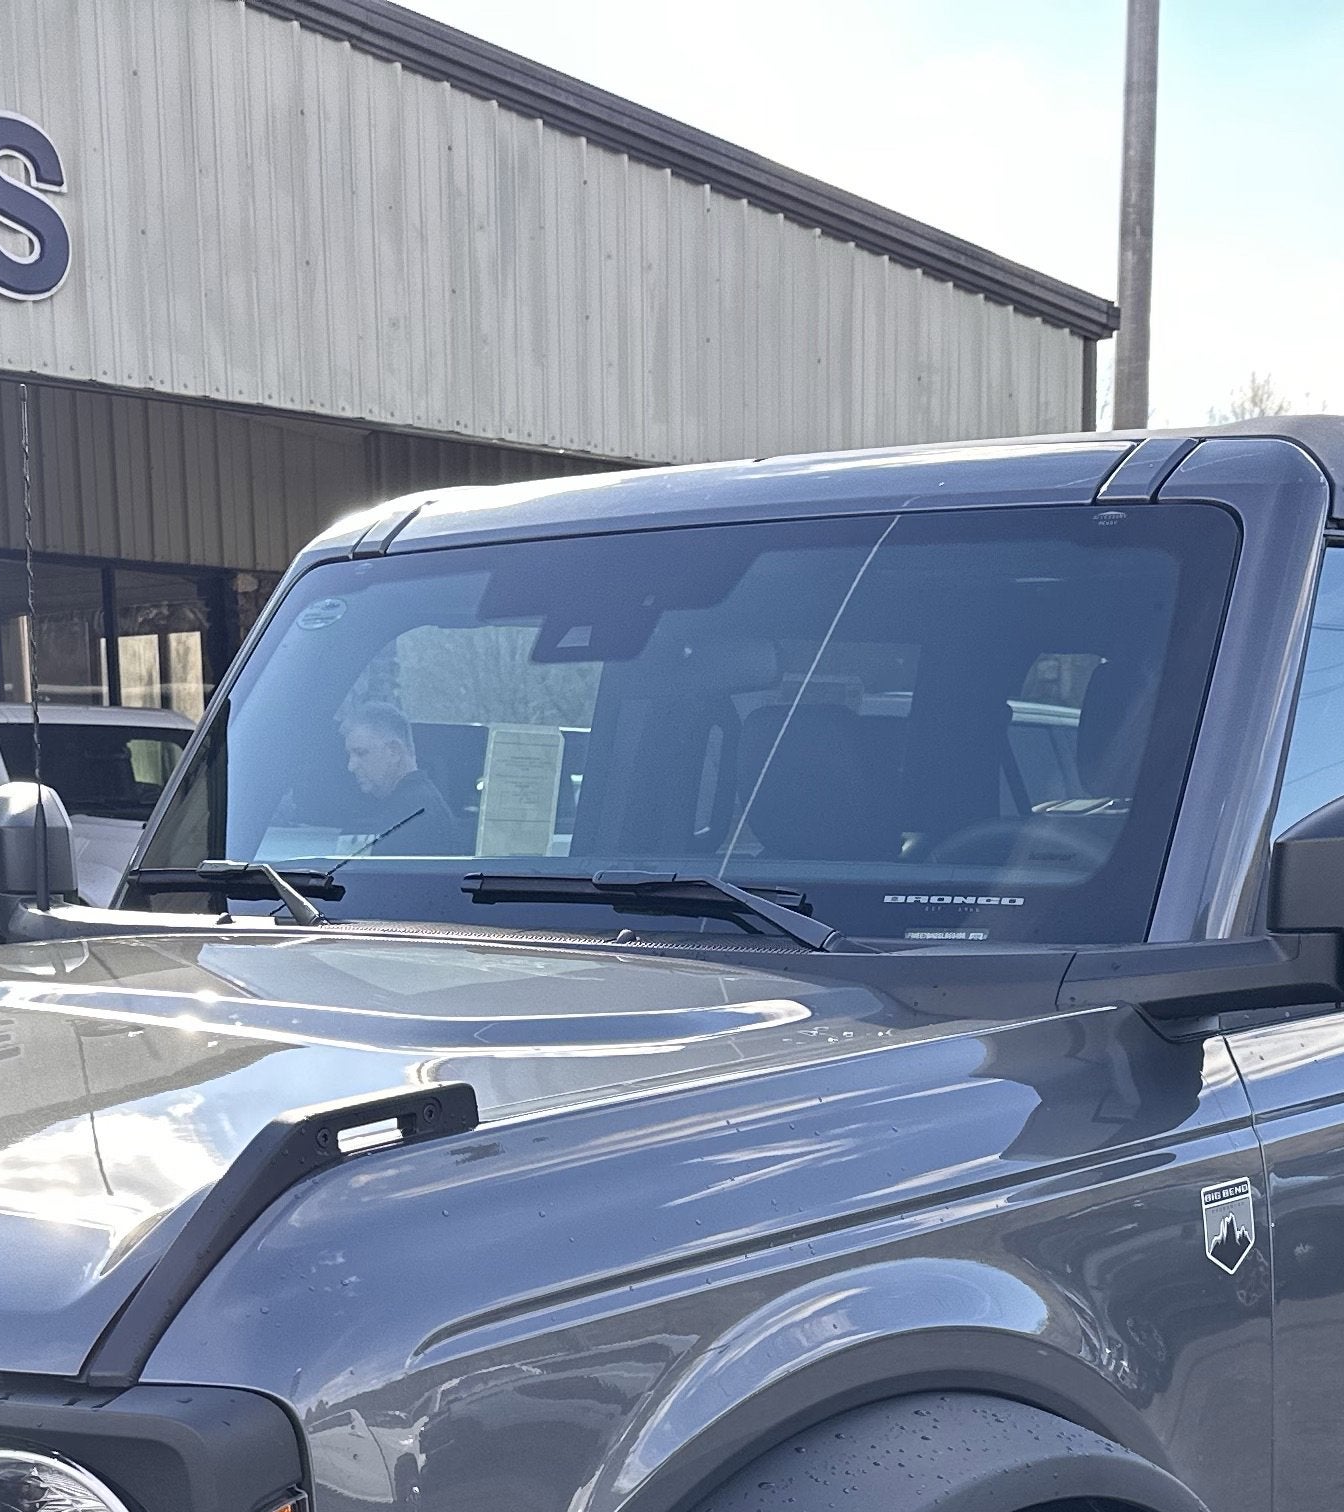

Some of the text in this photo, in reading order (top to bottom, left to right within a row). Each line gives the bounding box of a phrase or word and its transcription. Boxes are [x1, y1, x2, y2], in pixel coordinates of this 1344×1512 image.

[883, 895, 1025, 906] BRONCO
[1204, 1183, 1248, 1203] BIG BEND
